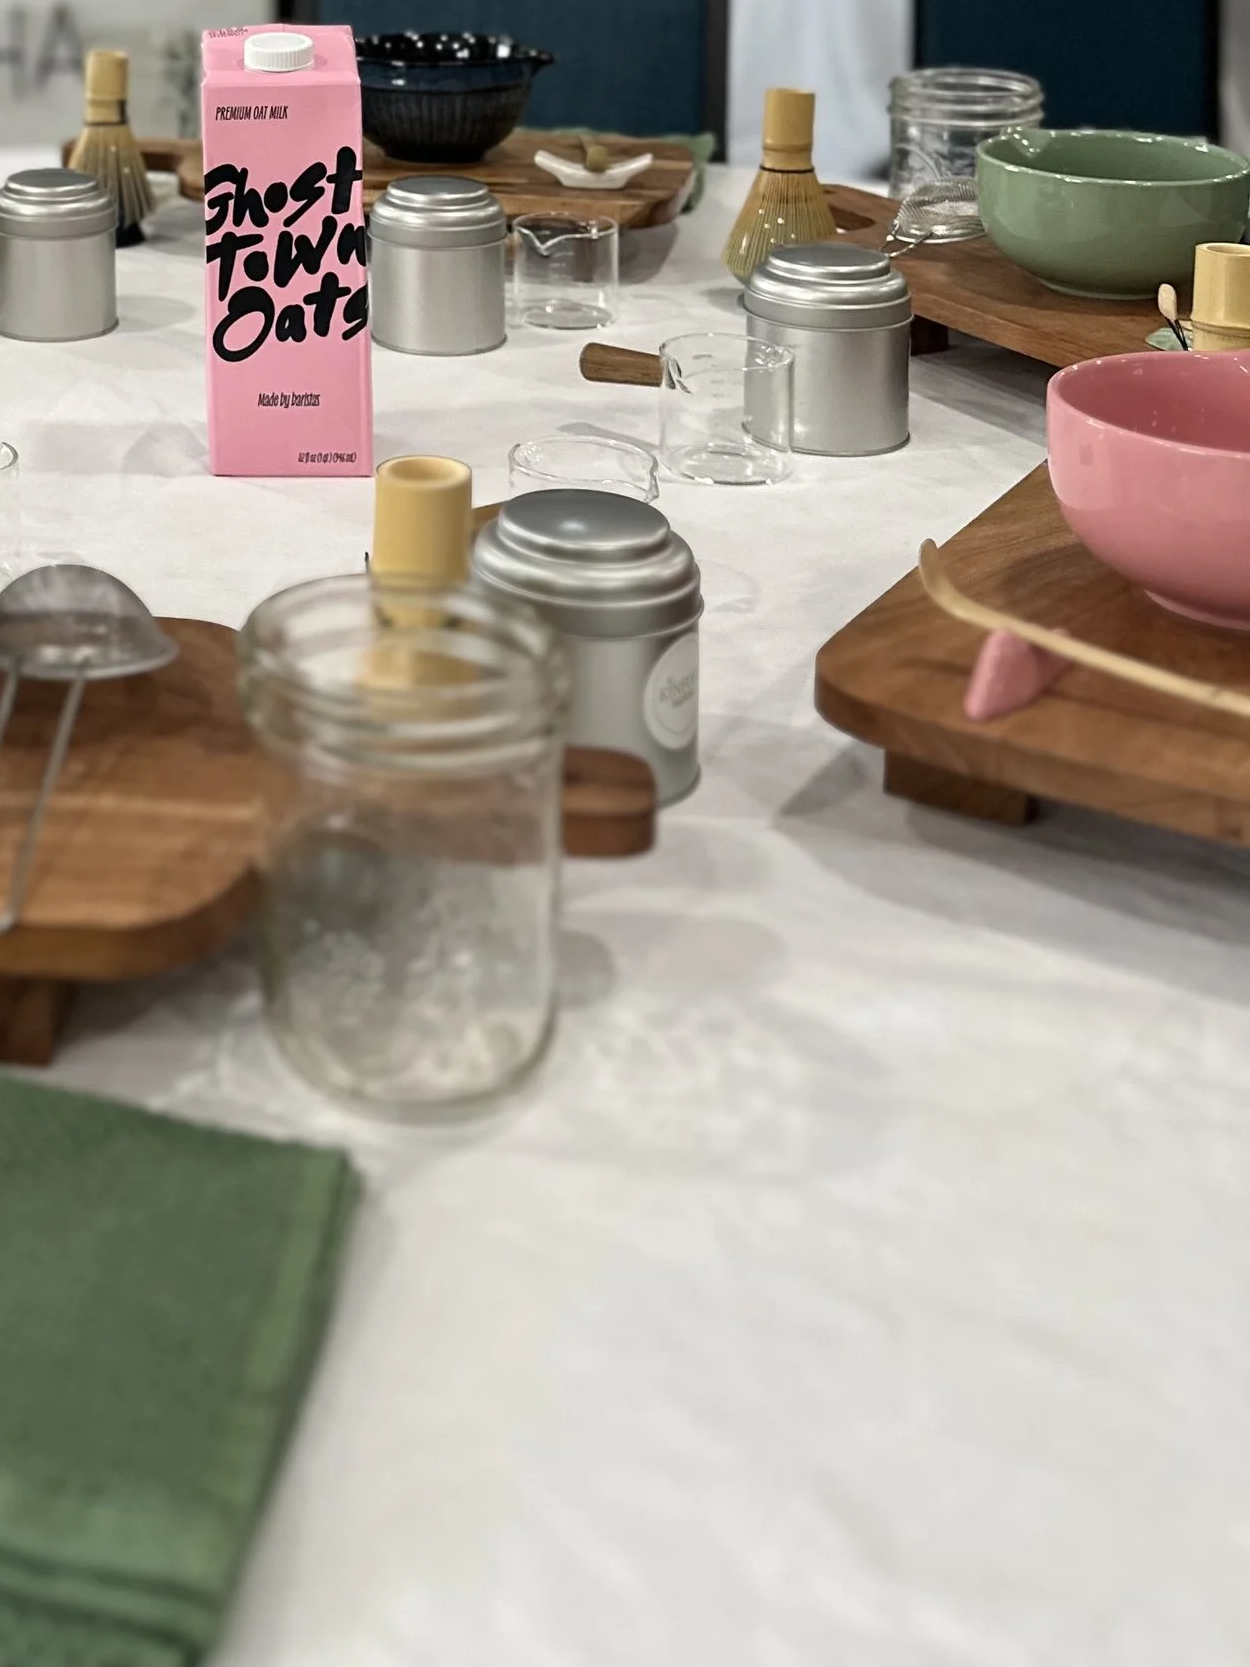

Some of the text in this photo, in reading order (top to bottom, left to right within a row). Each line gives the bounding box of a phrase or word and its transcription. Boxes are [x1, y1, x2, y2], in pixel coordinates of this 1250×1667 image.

[215, 105, 289, 121] PREMIUM OAT MILK
[205, 146, 363, 236] Ghost
[213, 272, 368, 363] Oats
[257, 391, 321, 409] Made by baristas
